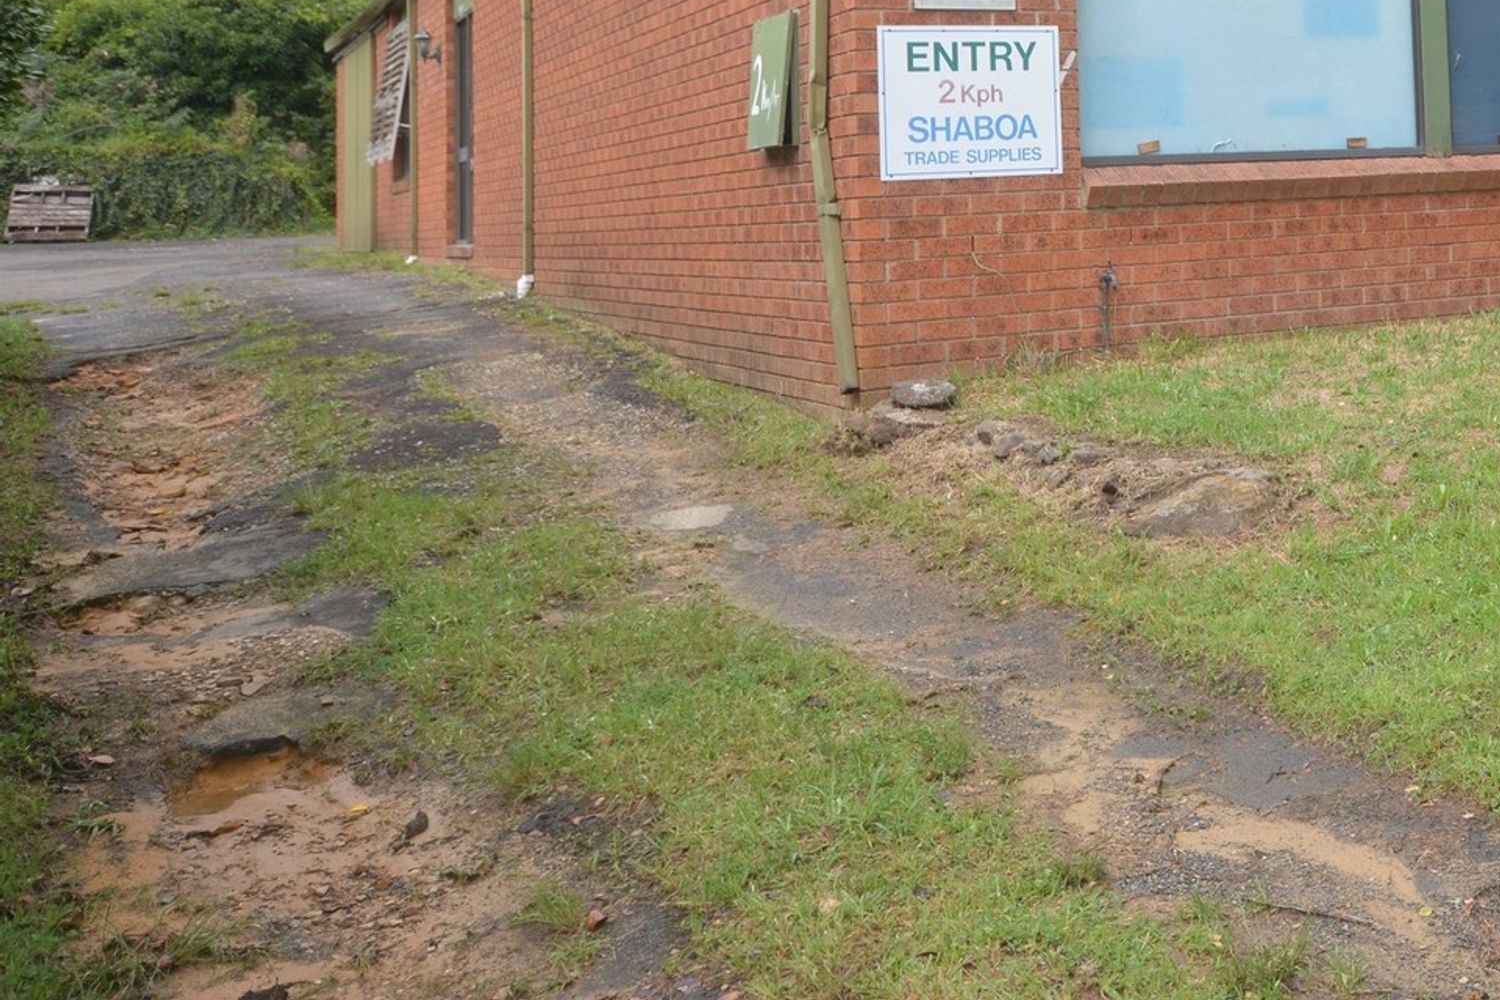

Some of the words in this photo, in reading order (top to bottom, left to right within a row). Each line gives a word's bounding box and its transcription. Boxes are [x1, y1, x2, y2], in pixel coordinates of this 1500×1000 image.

[906, 41, 1037, 73] ENTRY
[938, 80, 956, 104] 2
[961, 85, 1003, 107] Kph
[908, 114, 1038, 144] SHABOA
[904, 150, 960, 166] TRADE
[966, 146, 1042, 165] SUPPLIES
